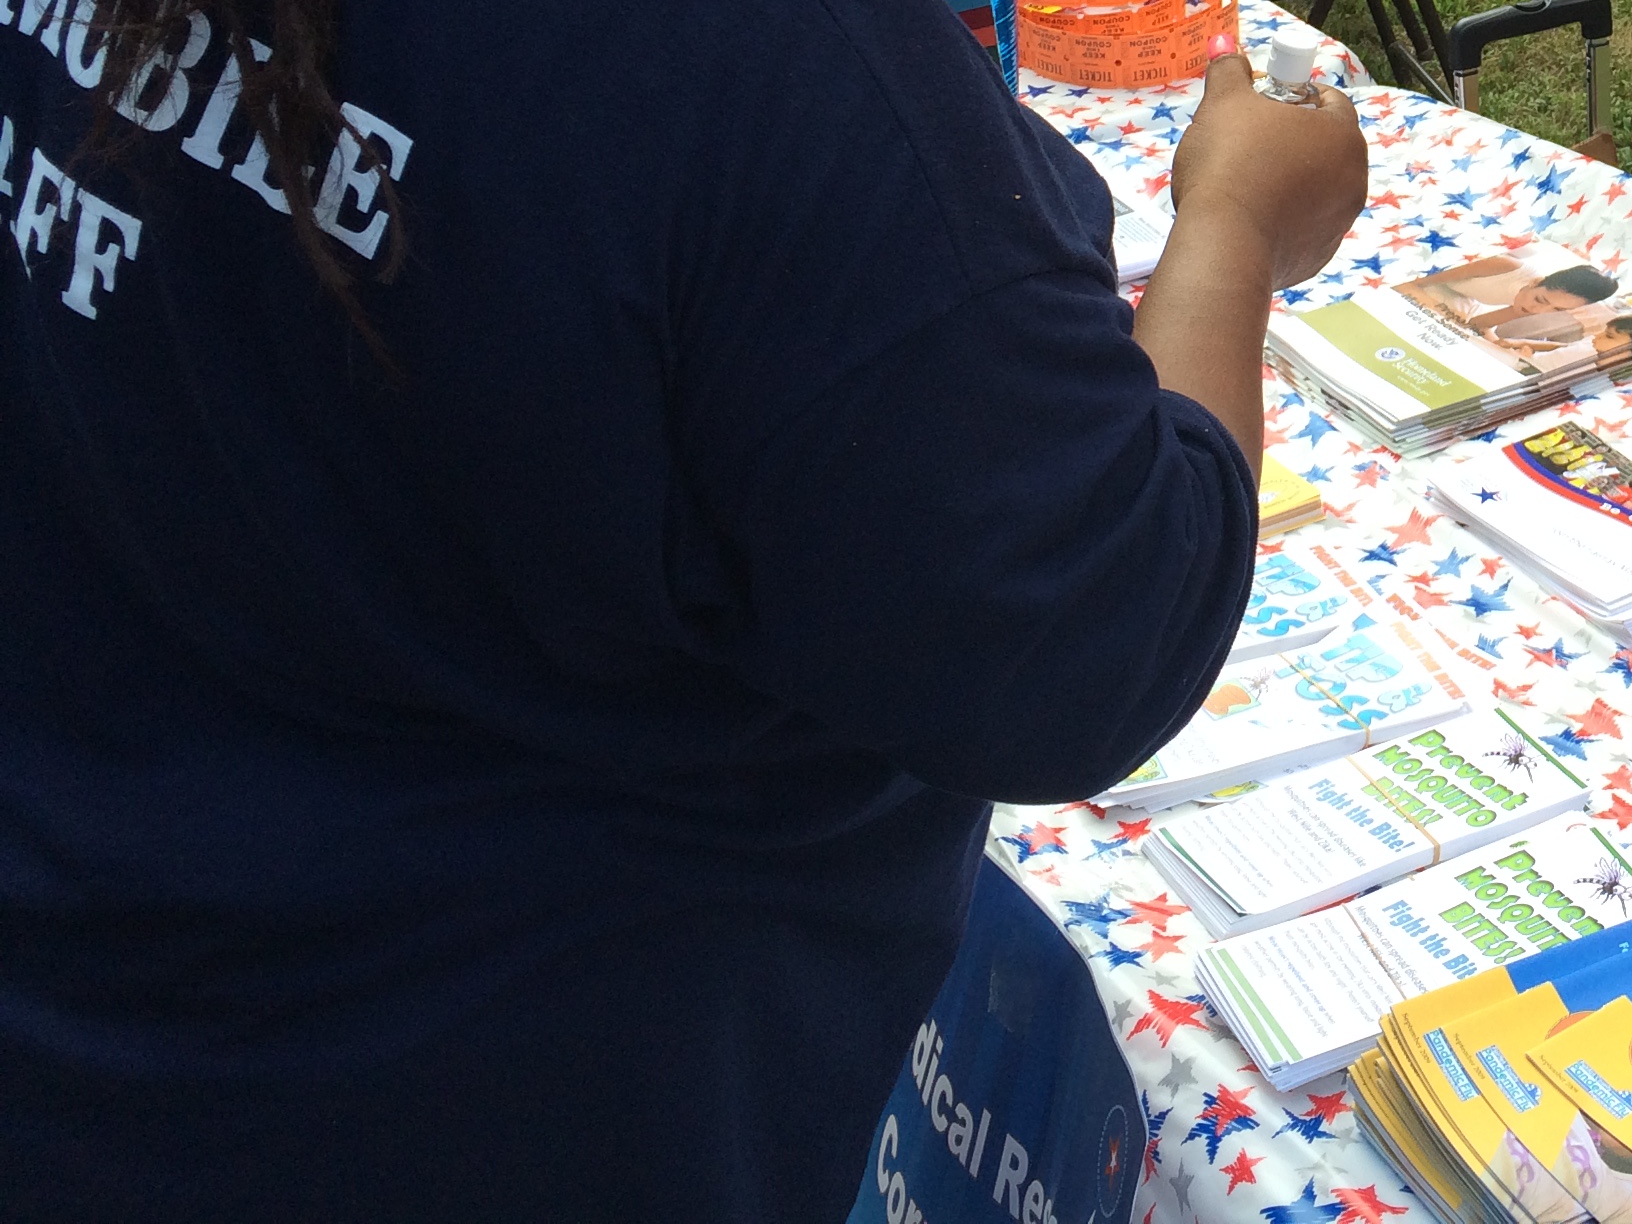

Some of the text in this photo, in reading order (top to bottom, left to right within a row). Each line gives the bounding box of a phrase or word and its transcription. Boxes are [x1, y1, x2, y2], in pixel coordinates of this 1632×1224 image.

[1079, 68, 1113, 82] TICKET
[1082, 51, 1106, 59] KEEP
[1133, 66, 1168, 82] TICKET
[1138, 48, 1162, 58] KEEP
[1404, 309, 1458, 346] Get Ready
[1402, 357, 1452, 387] Homeland
[1599, 501, 1621, 515] Be
[1252, 553, 1321, 596] TIP
[1320, 633, 1404, 684] TIP
[1274, 653, 1389, 731] TOSS
[1371, 744, 1498, 827] MOSQUITO
[1407, 728, 1531, 812] Prevent
[1307, 778, 1415, 852] Fight the Bite!
[1361, 775, 1442, 828] BITES!
[1453, 865, 1570, 952] MOSQUIT
[1494, 849, 1605, 938] Preven
[1380, 936, 1410, 969] can spread
[1381, 899, 1452, 957] Fight the
[1439, 901, 1526, 965] BITES!
[1428, 1029, 1474, 1098] Pandemic Flu
[1480, 1048, 1531, 1110] Pandemic Flu
[1571, 1064, 1629, 1116] Pandemic Flu
[912, 1019, 992, 1178] dical
